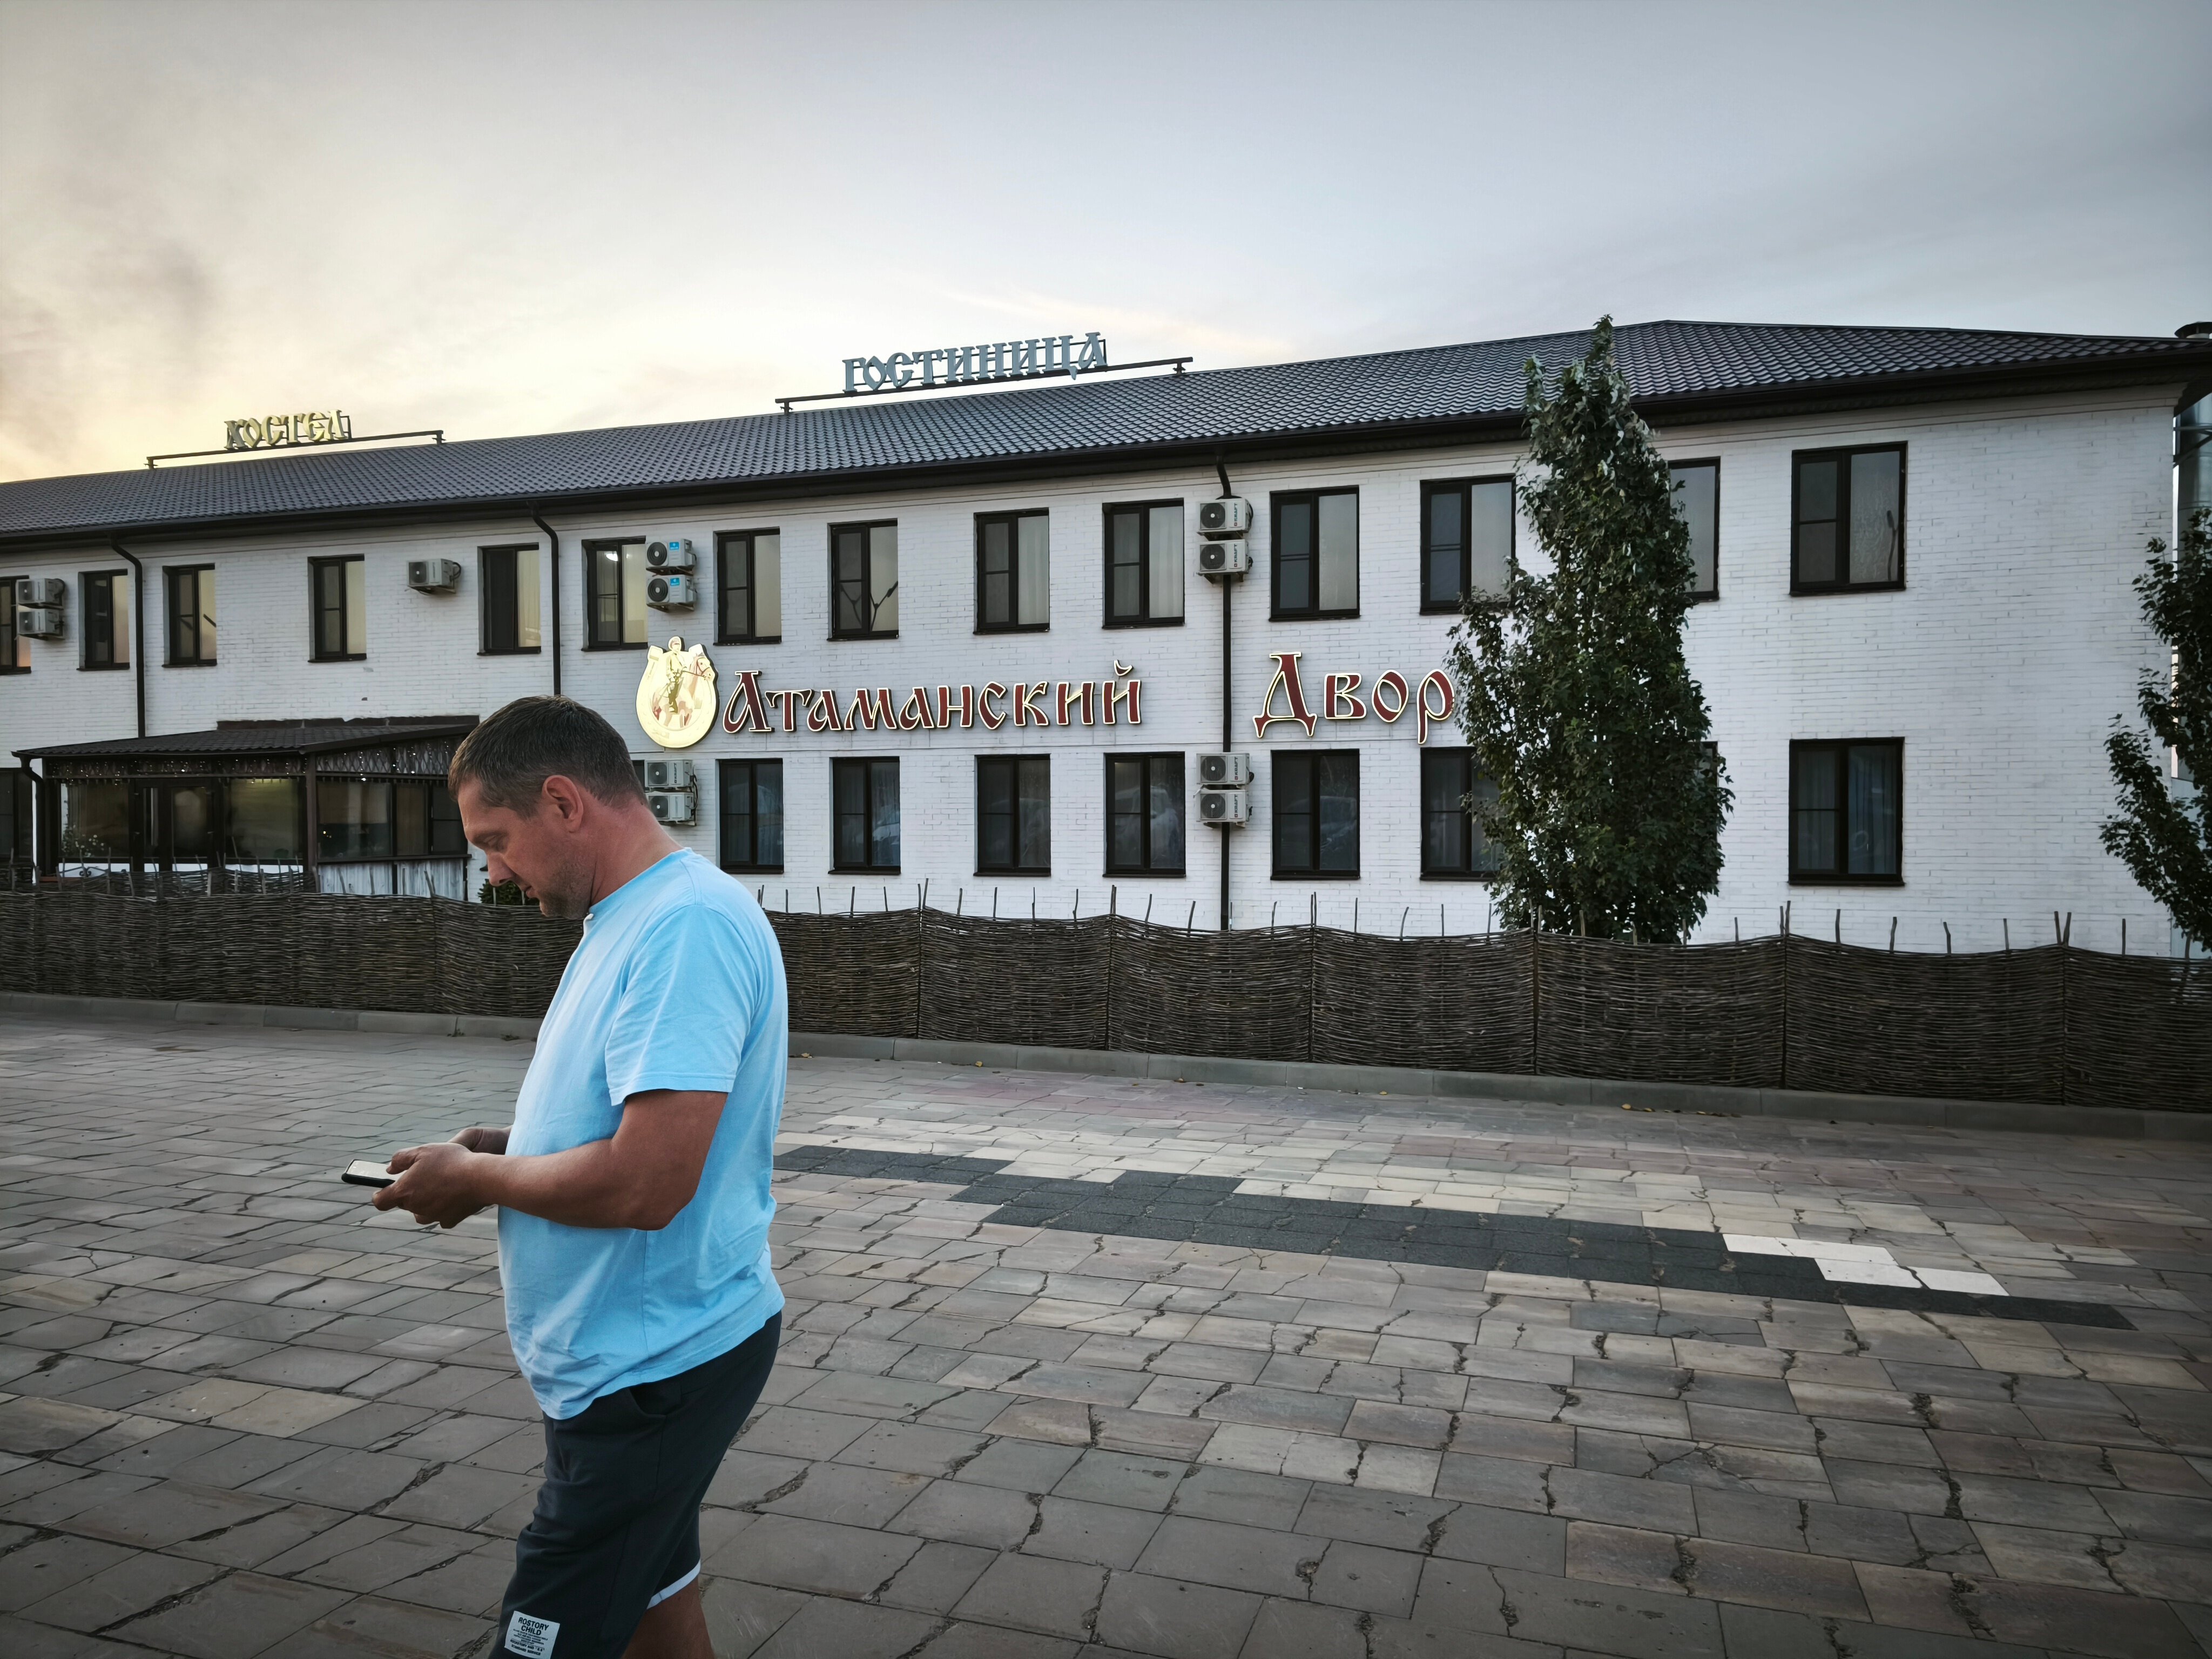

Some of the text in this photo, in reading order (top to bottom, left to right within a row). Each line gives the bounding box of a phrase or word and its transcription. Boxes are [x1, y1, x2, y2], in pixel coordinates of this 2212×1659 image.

[842, 332, 1108, 393] ГОСТИНИЦА
[224, 409, 348, 450] ХОСТЕЛ
[722, 651, 1455, 745] Атаманский Двор
[518, 1617, 549, 1630] ROSTORY
[521, 1625, 541, 1635] CHILD
